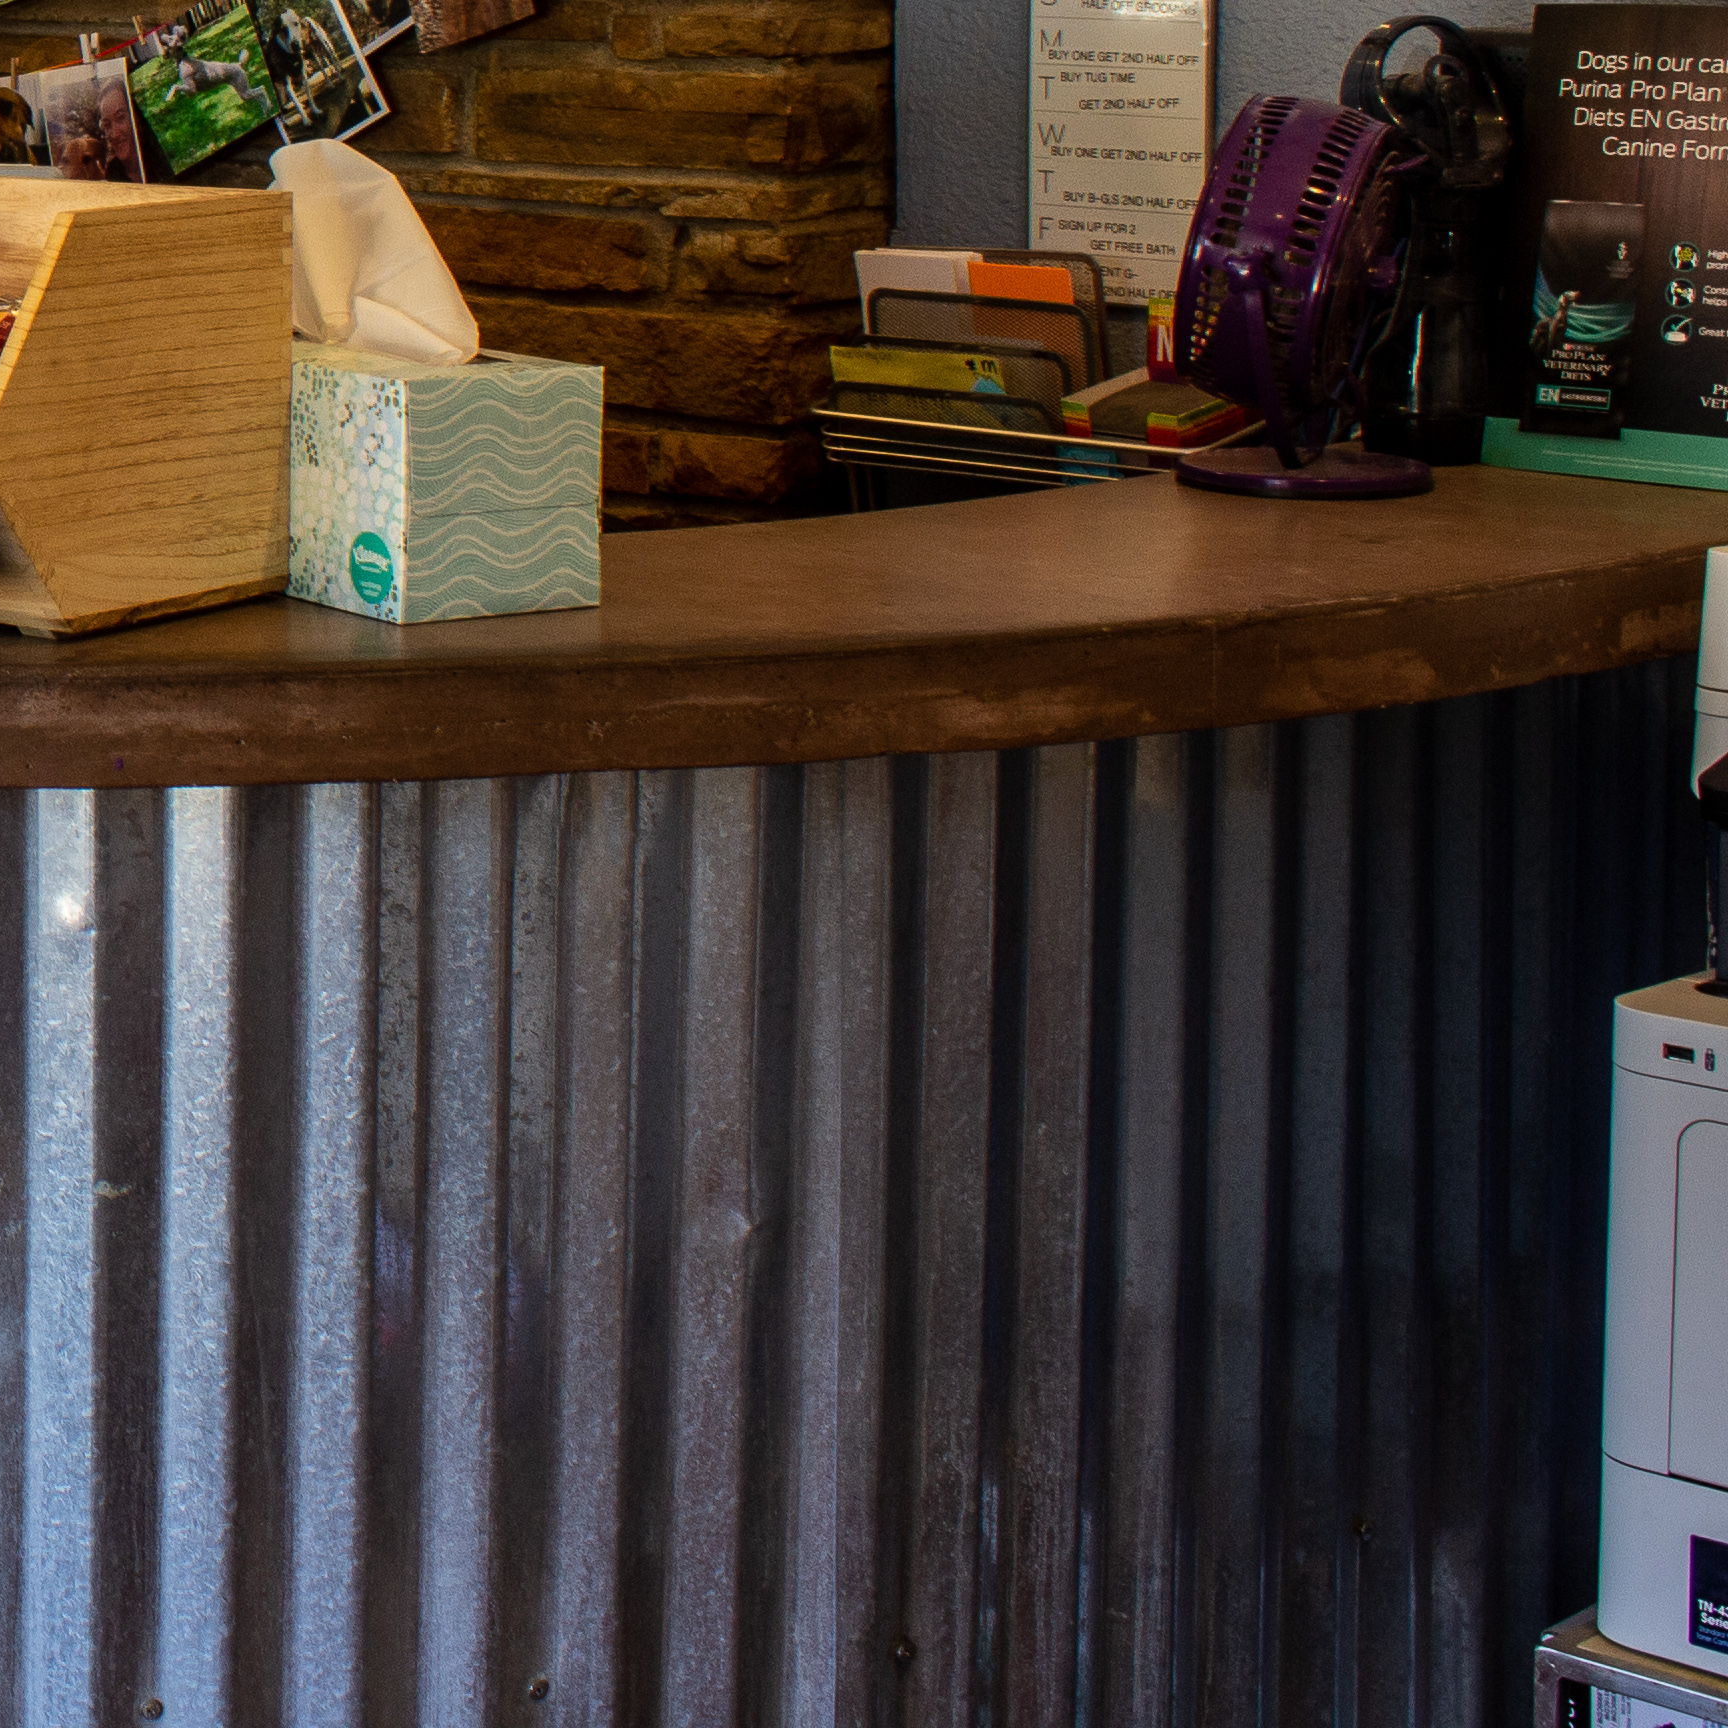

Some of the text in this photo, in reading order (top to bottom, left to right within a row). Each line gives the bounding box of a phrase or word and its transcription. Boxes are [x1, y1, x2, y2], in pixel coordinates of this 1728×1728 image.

[1081, 0, 1109, 9] HALF
[1111, 0, 1133, 10] OFF
[1040, 29, 1063, 52] M
[1048, 49, 1199, 65] BUY ONE GET 2ND HALF OFF
[1577, 50, 1630, 73] Dogs
[1633, 52, 1652, 70] in
[1657, 56, 1693, 72] our
[1060, 72, 1136, 83] BUY TUG TIME
[1038, 76, 1055, 100] T
[1559, 78, 1722, 102] Purina Pro Plan
[1079, 98, 1179, 110] GET 2ND HALF OFF
[1573, 107, 1728, 131] Diets EN Gastr
[1037, 123, 1066, 146] W
[1050, 146, 1202, 162] BUY ONE GET 2ND HALF OFF
[1602, 136, 1676, 158] Canine
[1037, 169, 1055, 193] T
[1063, 191, 1085, 202] BUY
[1121, 194, 1144, 206] 2ND
[1146, 197, 1175, 208] HALF
[1176, 199, 1199, 209] OFF
[1038, 217, 1054, 239] F
[1058, 220, 1136, 235] SIGN UP FOR 2
[1090, 240, 1176, 255] GET FREE BATH
[1128, 287, 1155, 298] HALF
[1574, 351, 1606, 361] PLAN
[1543, 359, 1613, 372] VETERINARY
[1561, 372, 1592, 381] DIETS
[1540, 387, 1559, 403] EN
